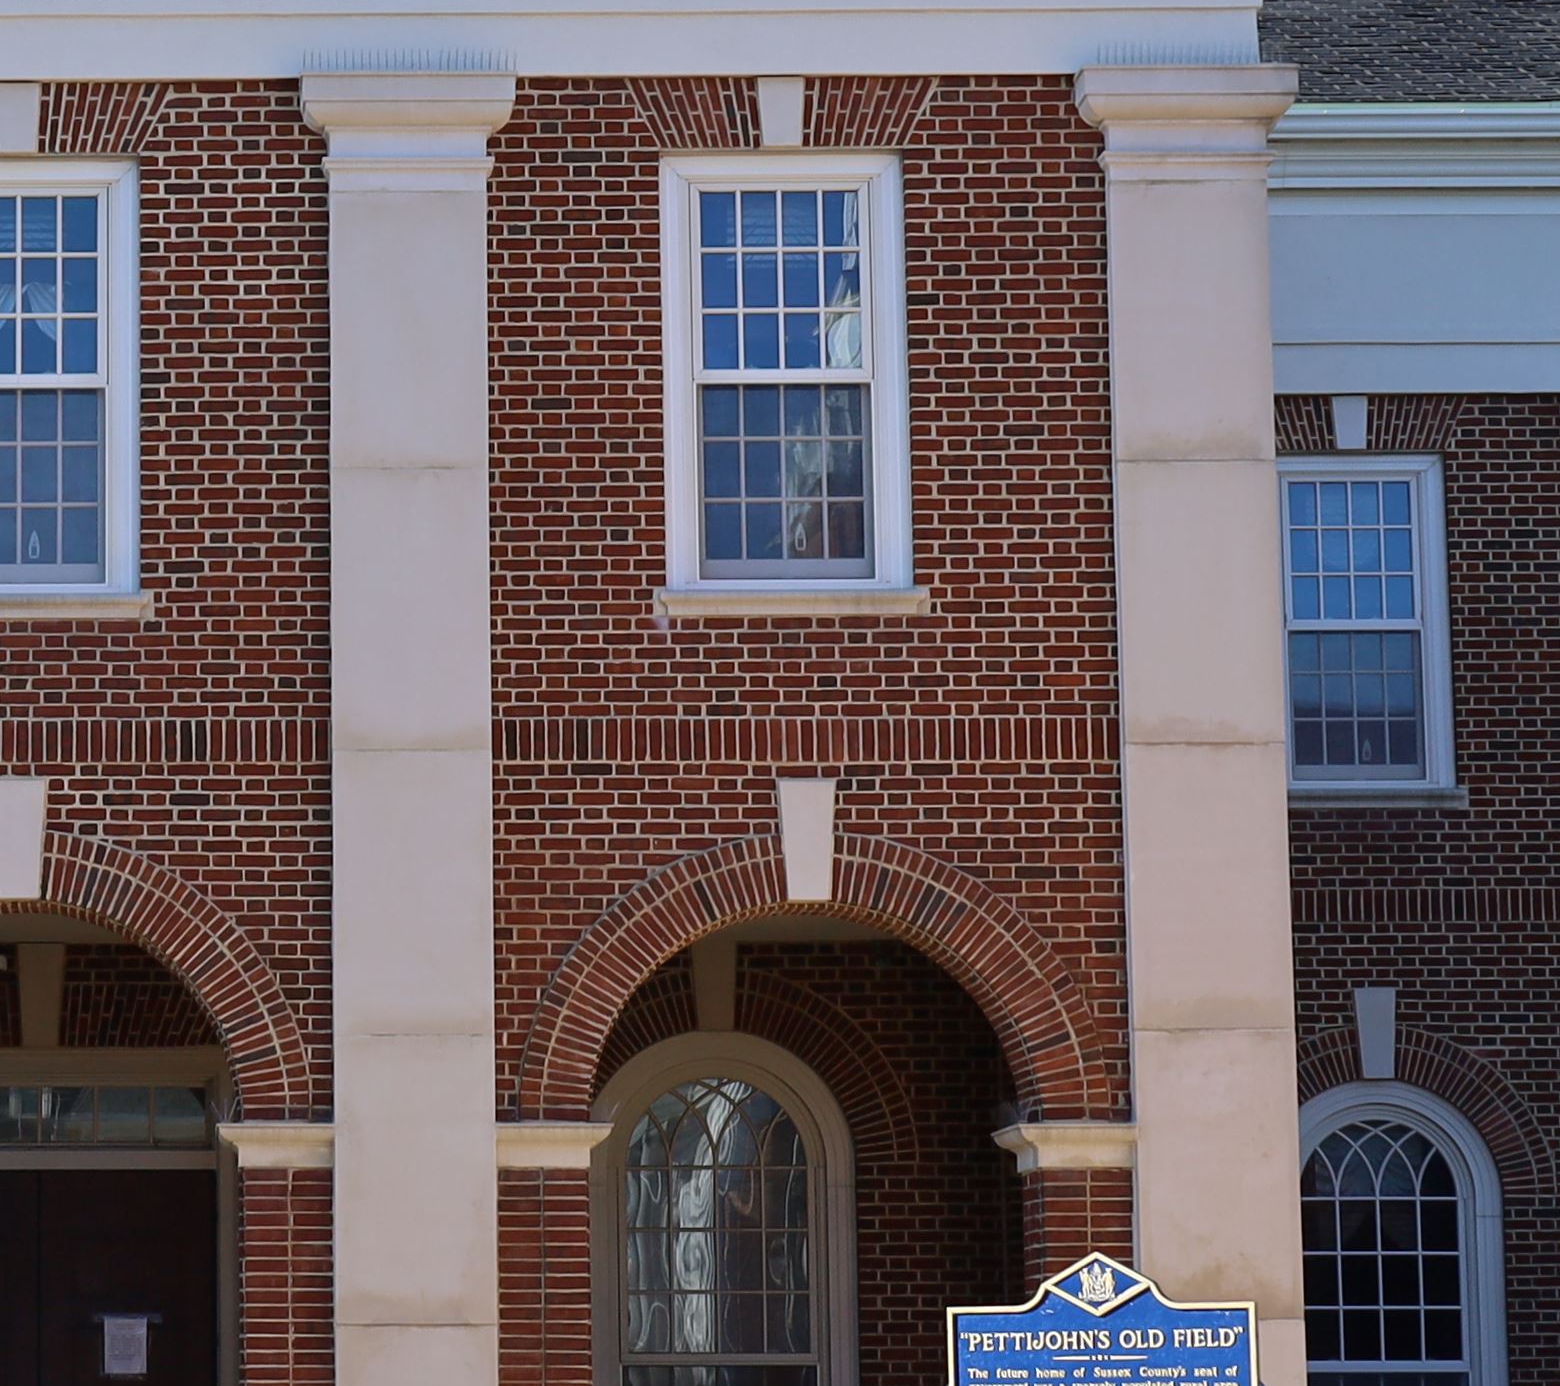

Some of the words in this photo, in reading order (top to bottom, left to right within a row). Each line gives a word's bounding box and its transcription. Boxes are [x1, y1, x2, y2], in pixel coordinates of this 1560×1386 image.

[960, 1329, 1112, 1352] "PETTIJOHN'S
[1119, 1328, 1165, 1349] OLD
[1173, 1326, 1243, 1349] FIELD"
[967, 1367, 989, 1379] The
[995, 1367, 1029, 1379] future
[1035, 1367, 1066, 1379] home
[1072, 1366, 1086, 1378] of
[1093, 1366, 1132, 1378] Sussex
[1139, 1366, 1187, 1380] County's
[1193, 1366, 1218, 1378] seat
[1224, 1366, 1238, 1378] of
